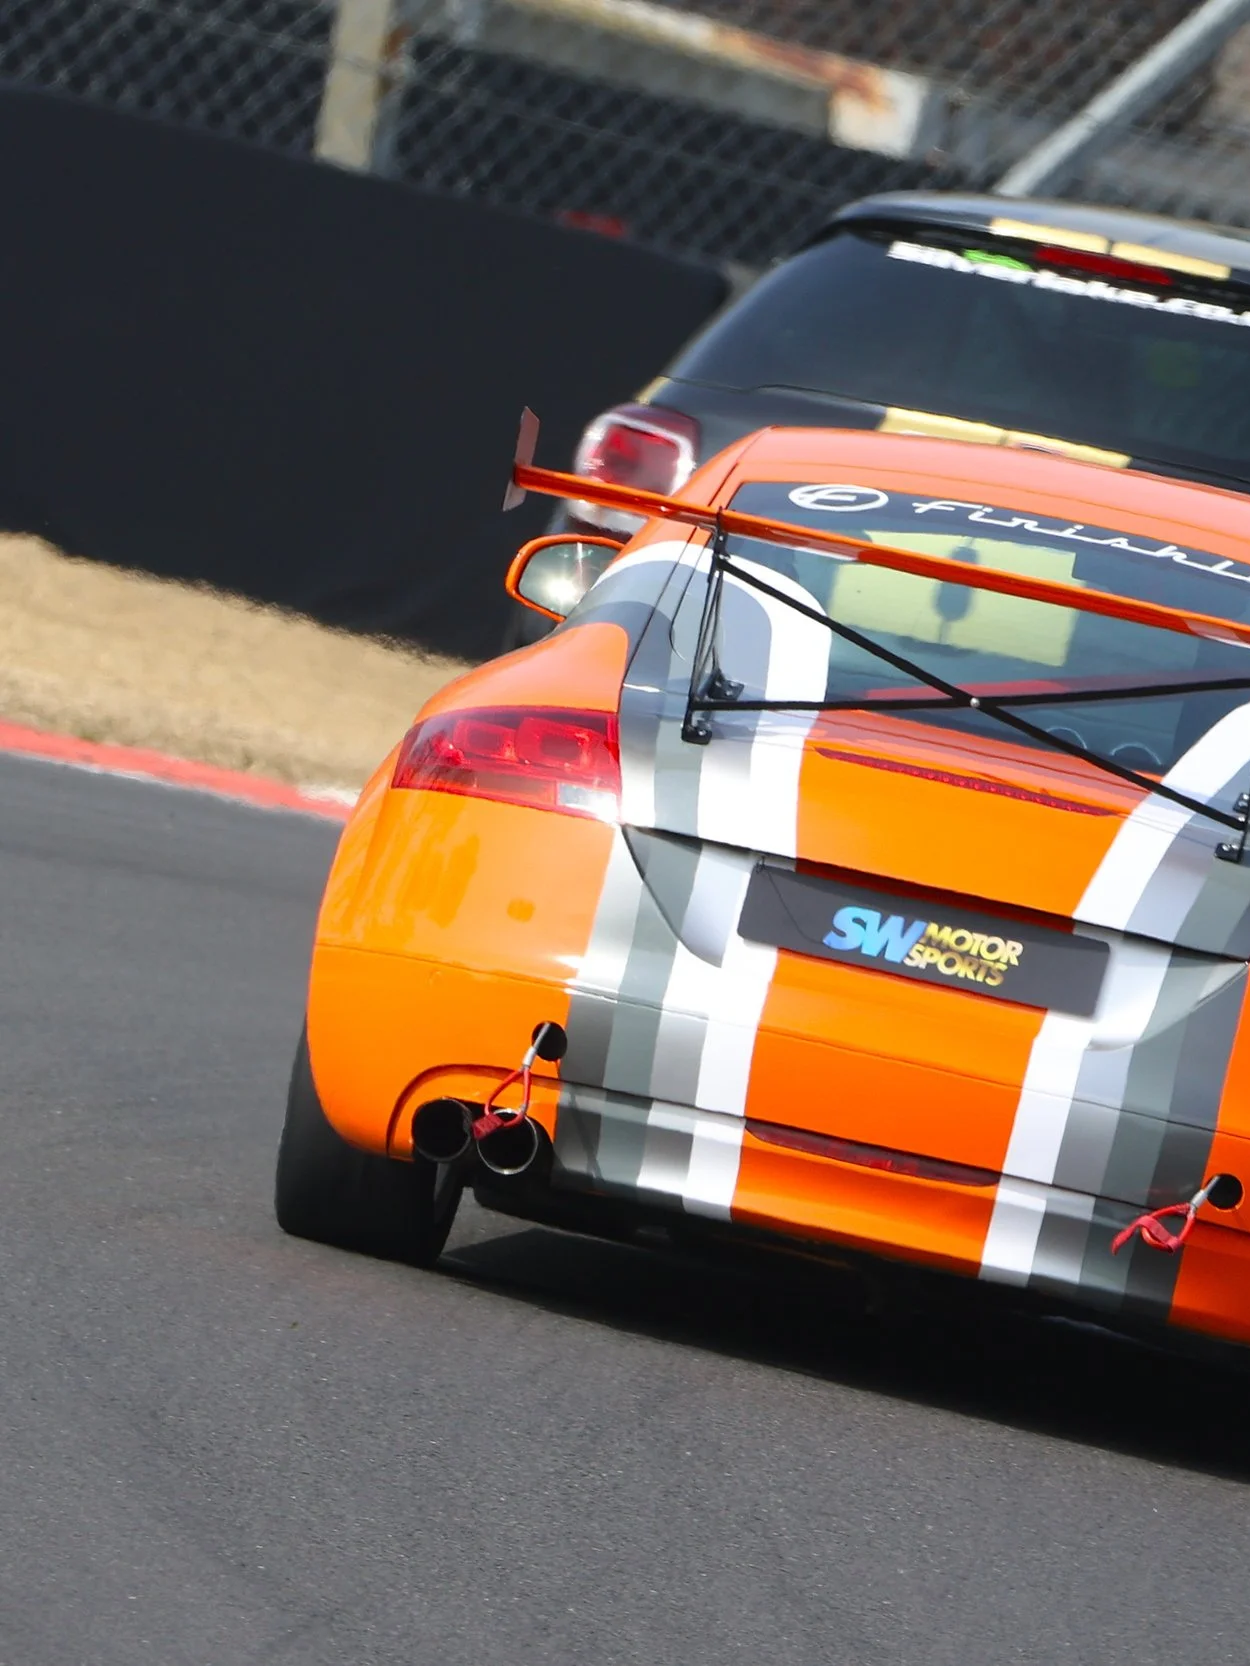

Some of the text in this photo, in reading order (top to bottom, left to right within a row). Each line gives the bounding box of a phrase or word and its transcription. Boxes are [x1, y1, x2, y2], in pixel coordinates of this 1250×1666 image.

[822, 906, 928, 964] SW
[921, 922, 1024, 966] MOTOR
[903, 943, 1009, 987] SPORTS
